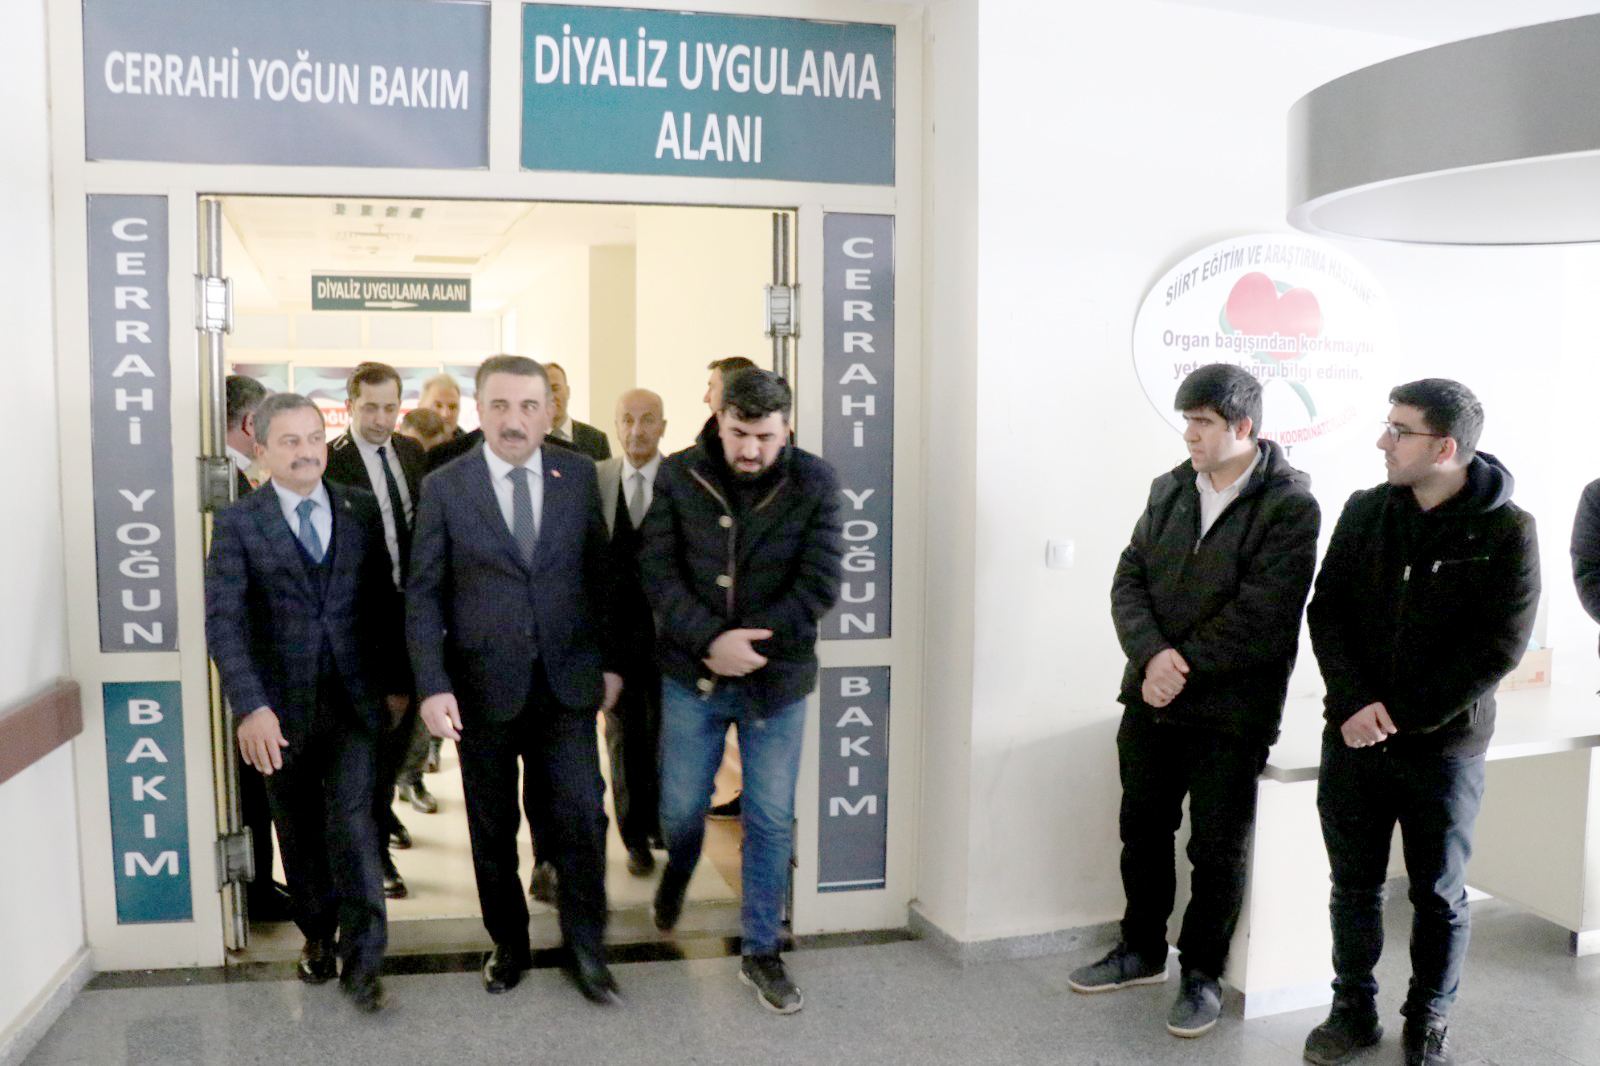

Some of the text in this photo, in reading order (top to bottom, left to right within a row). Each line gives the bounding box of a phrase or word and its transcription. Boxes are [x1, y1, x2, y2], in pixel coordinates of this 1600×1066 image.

[104, 47, 469, 110] CERRAHİ YOĞUN BAKIM
[534, 23, 882, 101] DİYALİZ UYGULAMA
[655, 111, 763, 163] ALANI
[317, 278, 467, 301] DİYALİZ UYGULAMA ALANI
[1165, 264, 1200, 307] SİİRT
[1201, 244, 1244, 282] EĞİTİM
[1247, 245, 1263, 265] VE
[1264, 244, 1326, 274] ARAŞTIRMA
[1162, 330, 1374, 357] Organ bağışından korkmayın
[1280, 362, 1312, 383] bilgi
[115, 489, 164, 645] YOĞUN
[829, 676, 878, 817] BAKIM
[123, 699, 180, 878] BAKIM
